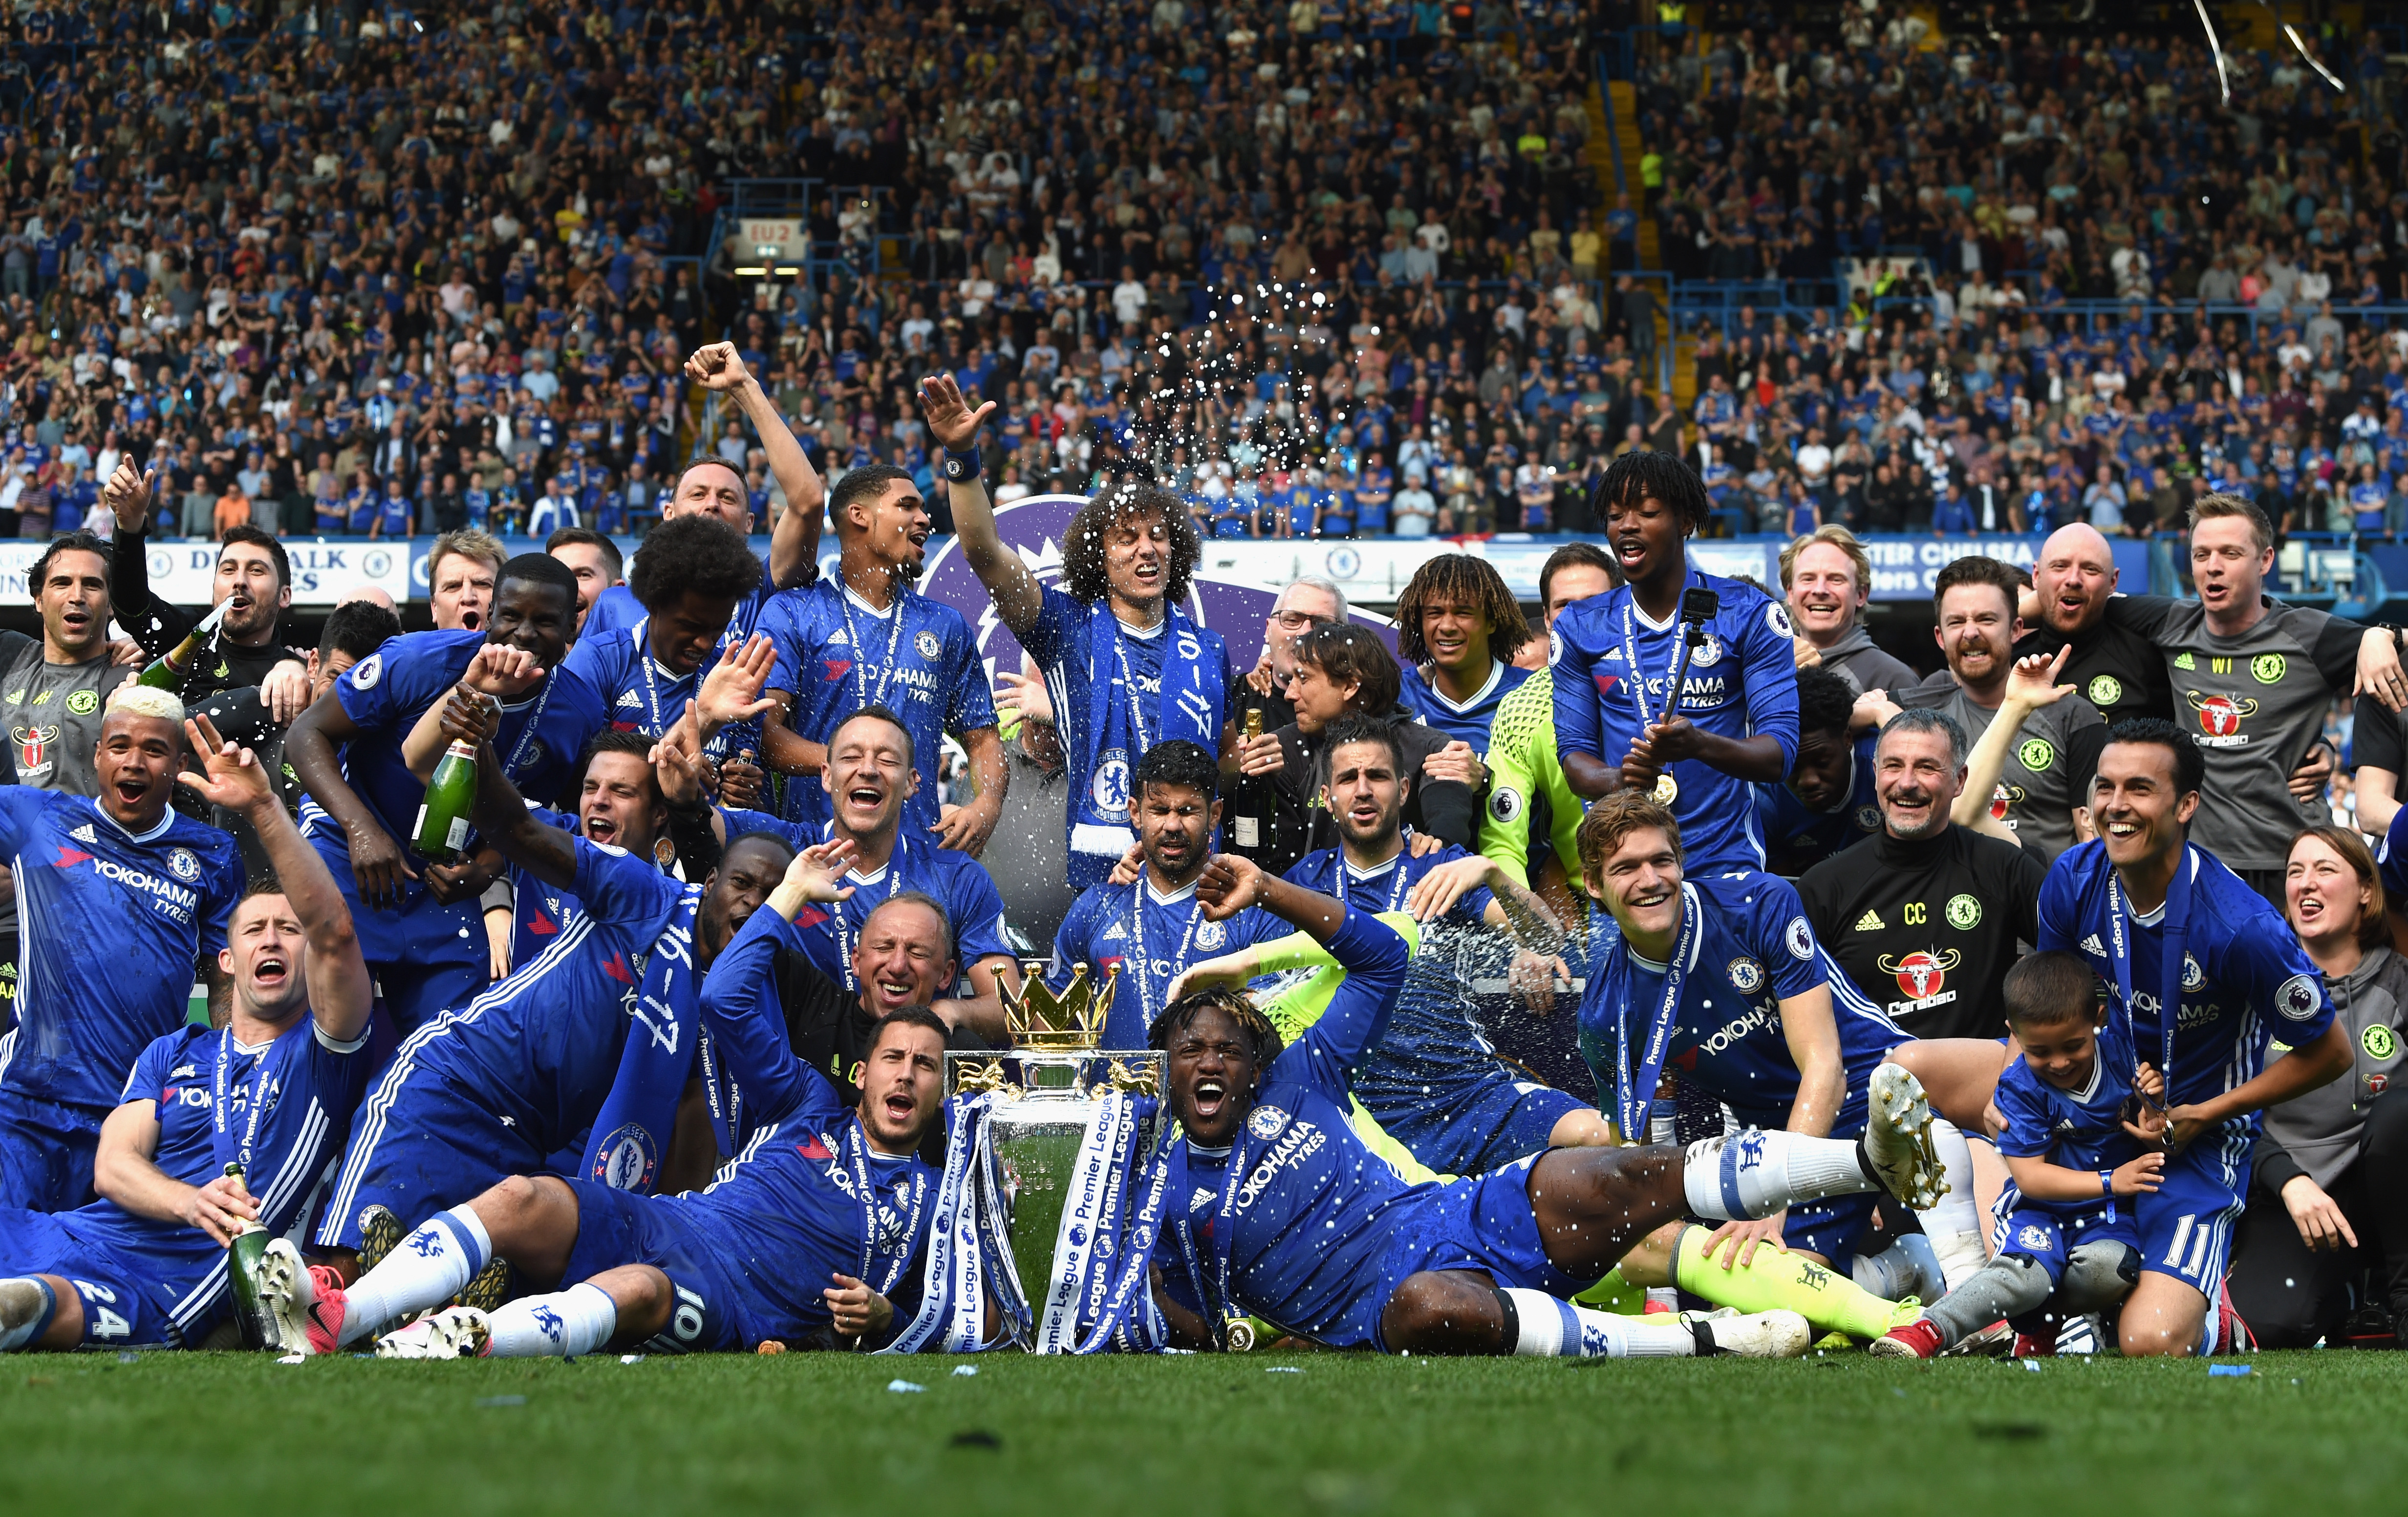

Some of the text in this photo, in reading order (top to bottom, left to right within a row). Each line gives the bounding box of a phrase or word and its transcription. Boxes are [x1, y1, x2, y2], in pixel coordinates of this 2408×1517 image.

[1919, 541, 2034, 565] CHELSEA
[875, 601, 905, 699] Premier League Premier
[1623, 605, 1649, 720] Premier League Premier
[1668, 639, 1682, 674] Premier
[537, 680, 554, 714] League
[642, 656, 661, 723] Premier League
[856, 663, 867, 696] League
[616, 699, 644, 709] adidas
[1131, 695, 1144, 729] Premier
[1681, 692, 1724, 708] TYRES
[511, 730, 533, 766] Premier
[1137, 728, 1147, 754] Leag
[2192, 733, 2249, 747] Carabao
[16, 760, 52, 777] arabao
[69, 830, 98, 844] adidas
[174, 848, 194, 861] CHELSEA
[93, 858, 197, 912] YOKOHAMA
[1390, 865, 1407, 898] League
[154, 898, 192, 925] TYRES
[1904, 902, 1926, 925] CC
[1951, 895, 1974, 905] CHELSEA
[2108, 869, 2125, 958] Premier League
[1176, 927, 1193, 959] Premier
[1855, 922, 1886, 932] adidas
[838, 931, 851, 970] Premier
[1133, 879, 1152, 1030] Premier League Premier League
[1729, 958, 1750, 972] CHELSEA
[2080, 942, 2107, 958] adidas
[1646, 891, 1692, 1065] Premier League Premier League
[1888, 990, 1956, 1017] Carabao
[216, 1063, 227, 1096] Premier
[699, 1037, 720, 1119] Premier League
[1619, 1043, 1628, 1084] League
[215, 1096, 226, 1133] League
[728, 1083, 739, 1122] League
[1249, 1107, 1264, 1127] CHELSEA
[241, 1107, 259, 1147] Premier
[1623, 1102, 1634, 1141] Premier
[849, 1125, 863, 1158] League
[1288, 1130, 1327, 1170] TYRES
[858, 1158, 872, 1190] Premier
[1236, 1120, 1316, 1216] YOKOHAMA
[1082, 1099, 1134, 1327] League Premier League
[1189, 1192, 1217, 1214] adidas
[1221, 1174, 1237, 1218] Premier
[865, 1205, 877, 1246] League
[880, 1172, 924, 1296] League Premier League
[1047, 1096, 1114, 1354] emier League Premier League
[1106, 1253, 1143, 1309] League
[1139, 1160, 1168, 1222] Premier
[2025, 1225, 2047, 1238] CHELSEA
[895, 1304, 937, 1353] Premier
[928, 1238, 945, 1302] League
[943, 1143, 959, 1208] Premier
[1178, 1219, 1203, 1302] Premier League
[2162, 1213, 2211, 1279] 11
[961, 1250, 978, 1313] League
[72, 1279, 131, 1340] 24
[674, 1281, 707, 1342] 10
[961, 1315, 976, 1351] mier
